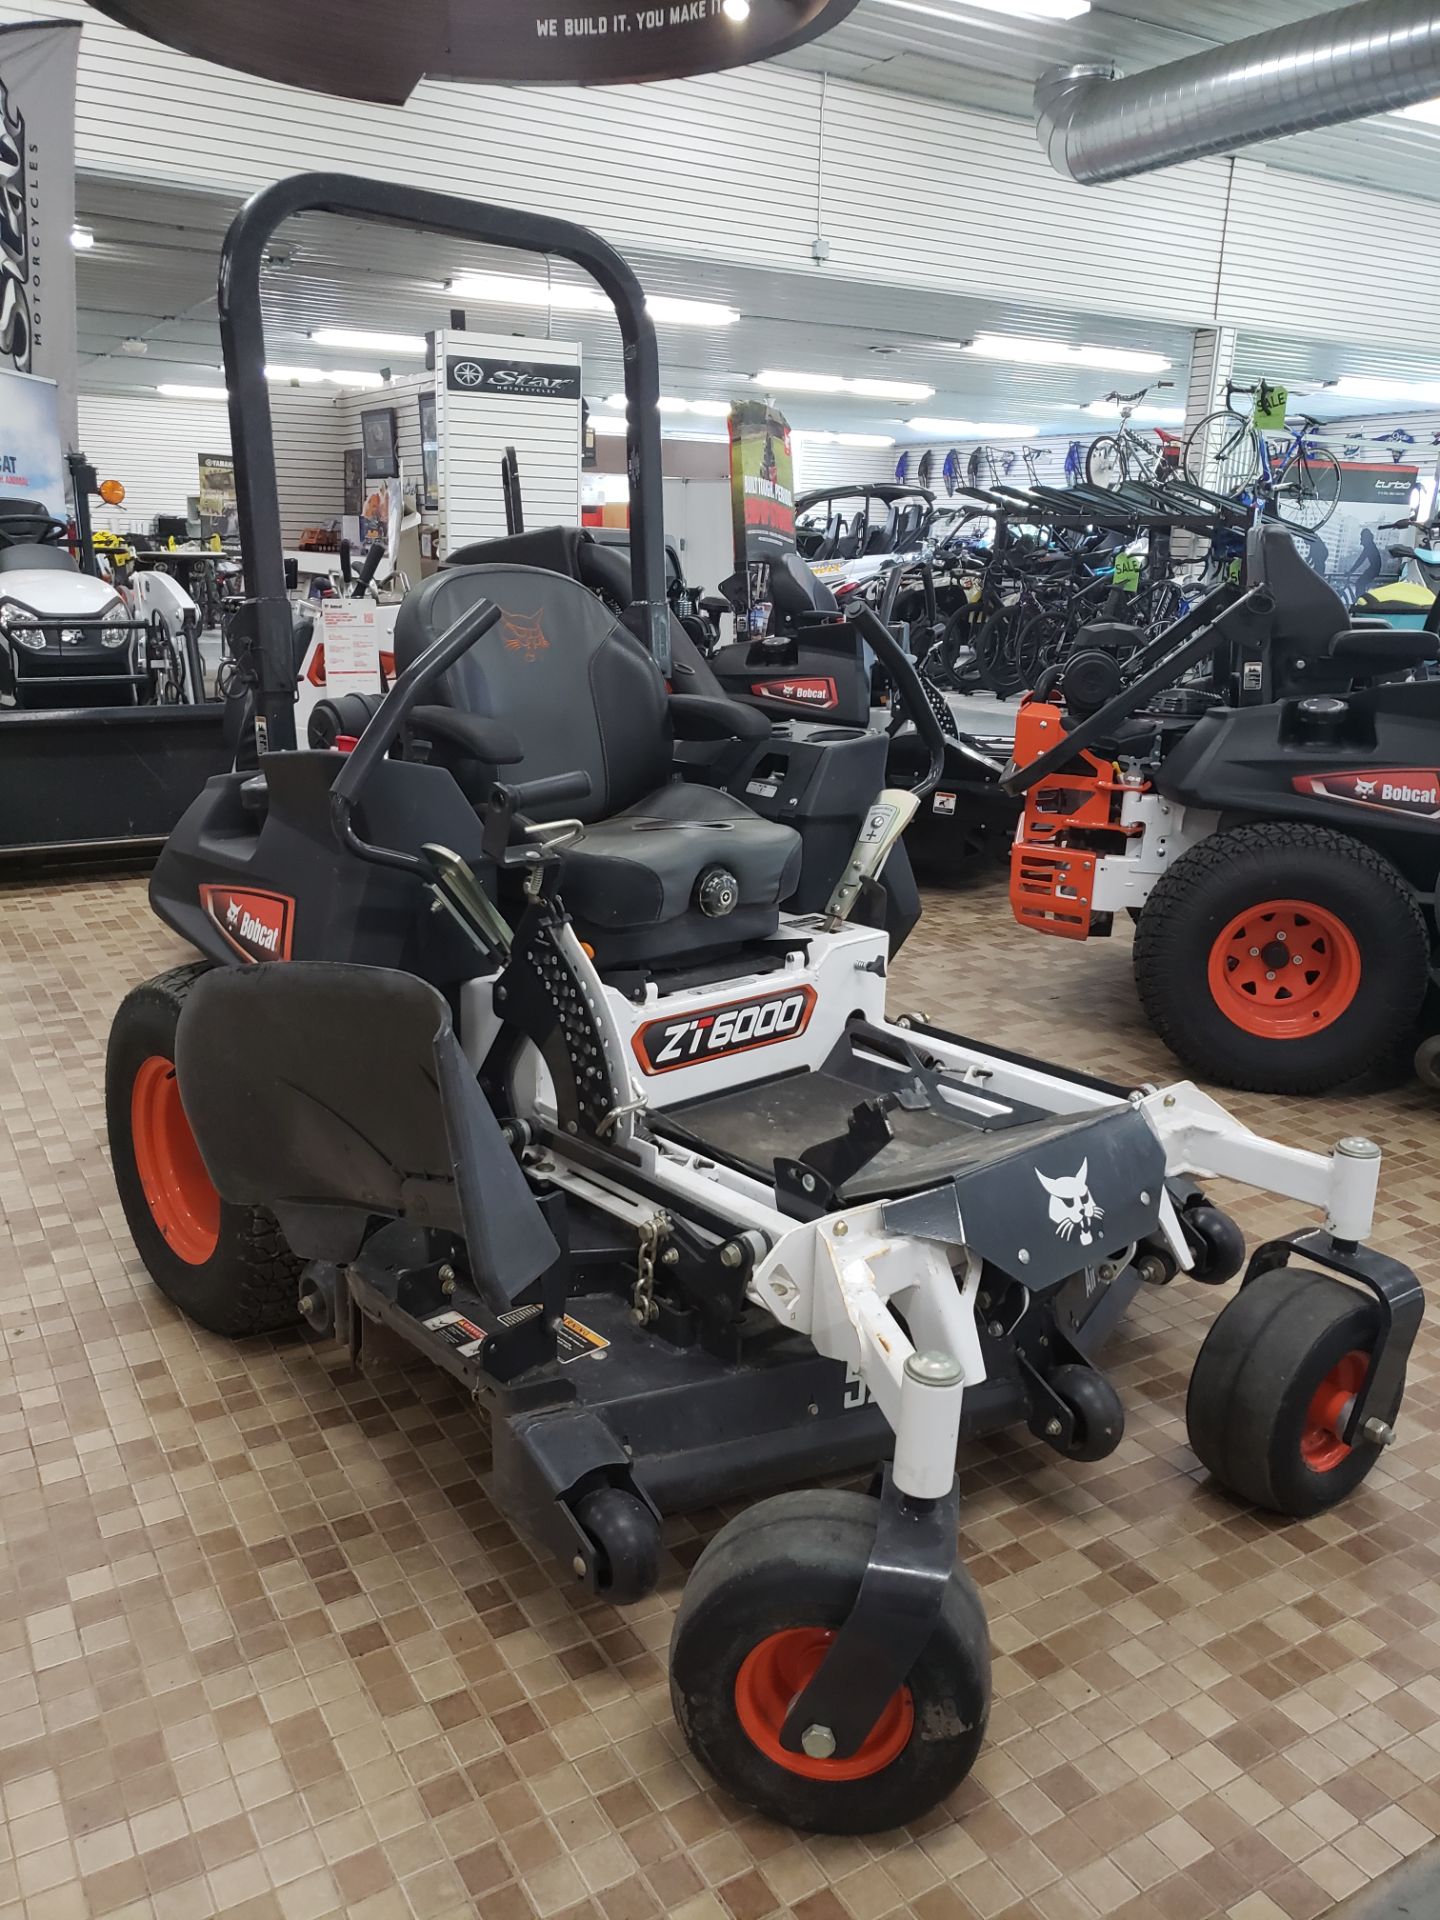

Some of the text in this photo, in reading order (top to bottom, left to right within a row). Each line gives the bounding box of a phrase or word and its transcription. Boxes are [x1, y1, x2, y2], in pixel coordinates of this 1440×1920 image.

[536, 19, 558, 37] WE
[564, 16, 608, 36] BUILD
[613, 14, 631, 33] IT.
[636, 9, 665, 30] YOU
[669, 1, 706, 25] MAKE
[28, 143, 42, 346] MOTORCYCLES
[486, 370, 575, 389] Star
[496, 386, 556, 394] MOTORCYCLES
[0, 455, 17, 474] AT
[1375, 479, 1411, 490] turbo
[1115, 561, 1138, 575] SALE
[796, 687, 827, 699] Bobcat
[1381, 784, 1437, 804] Bobcat
[240, 911, 279, 952] Bobcat
